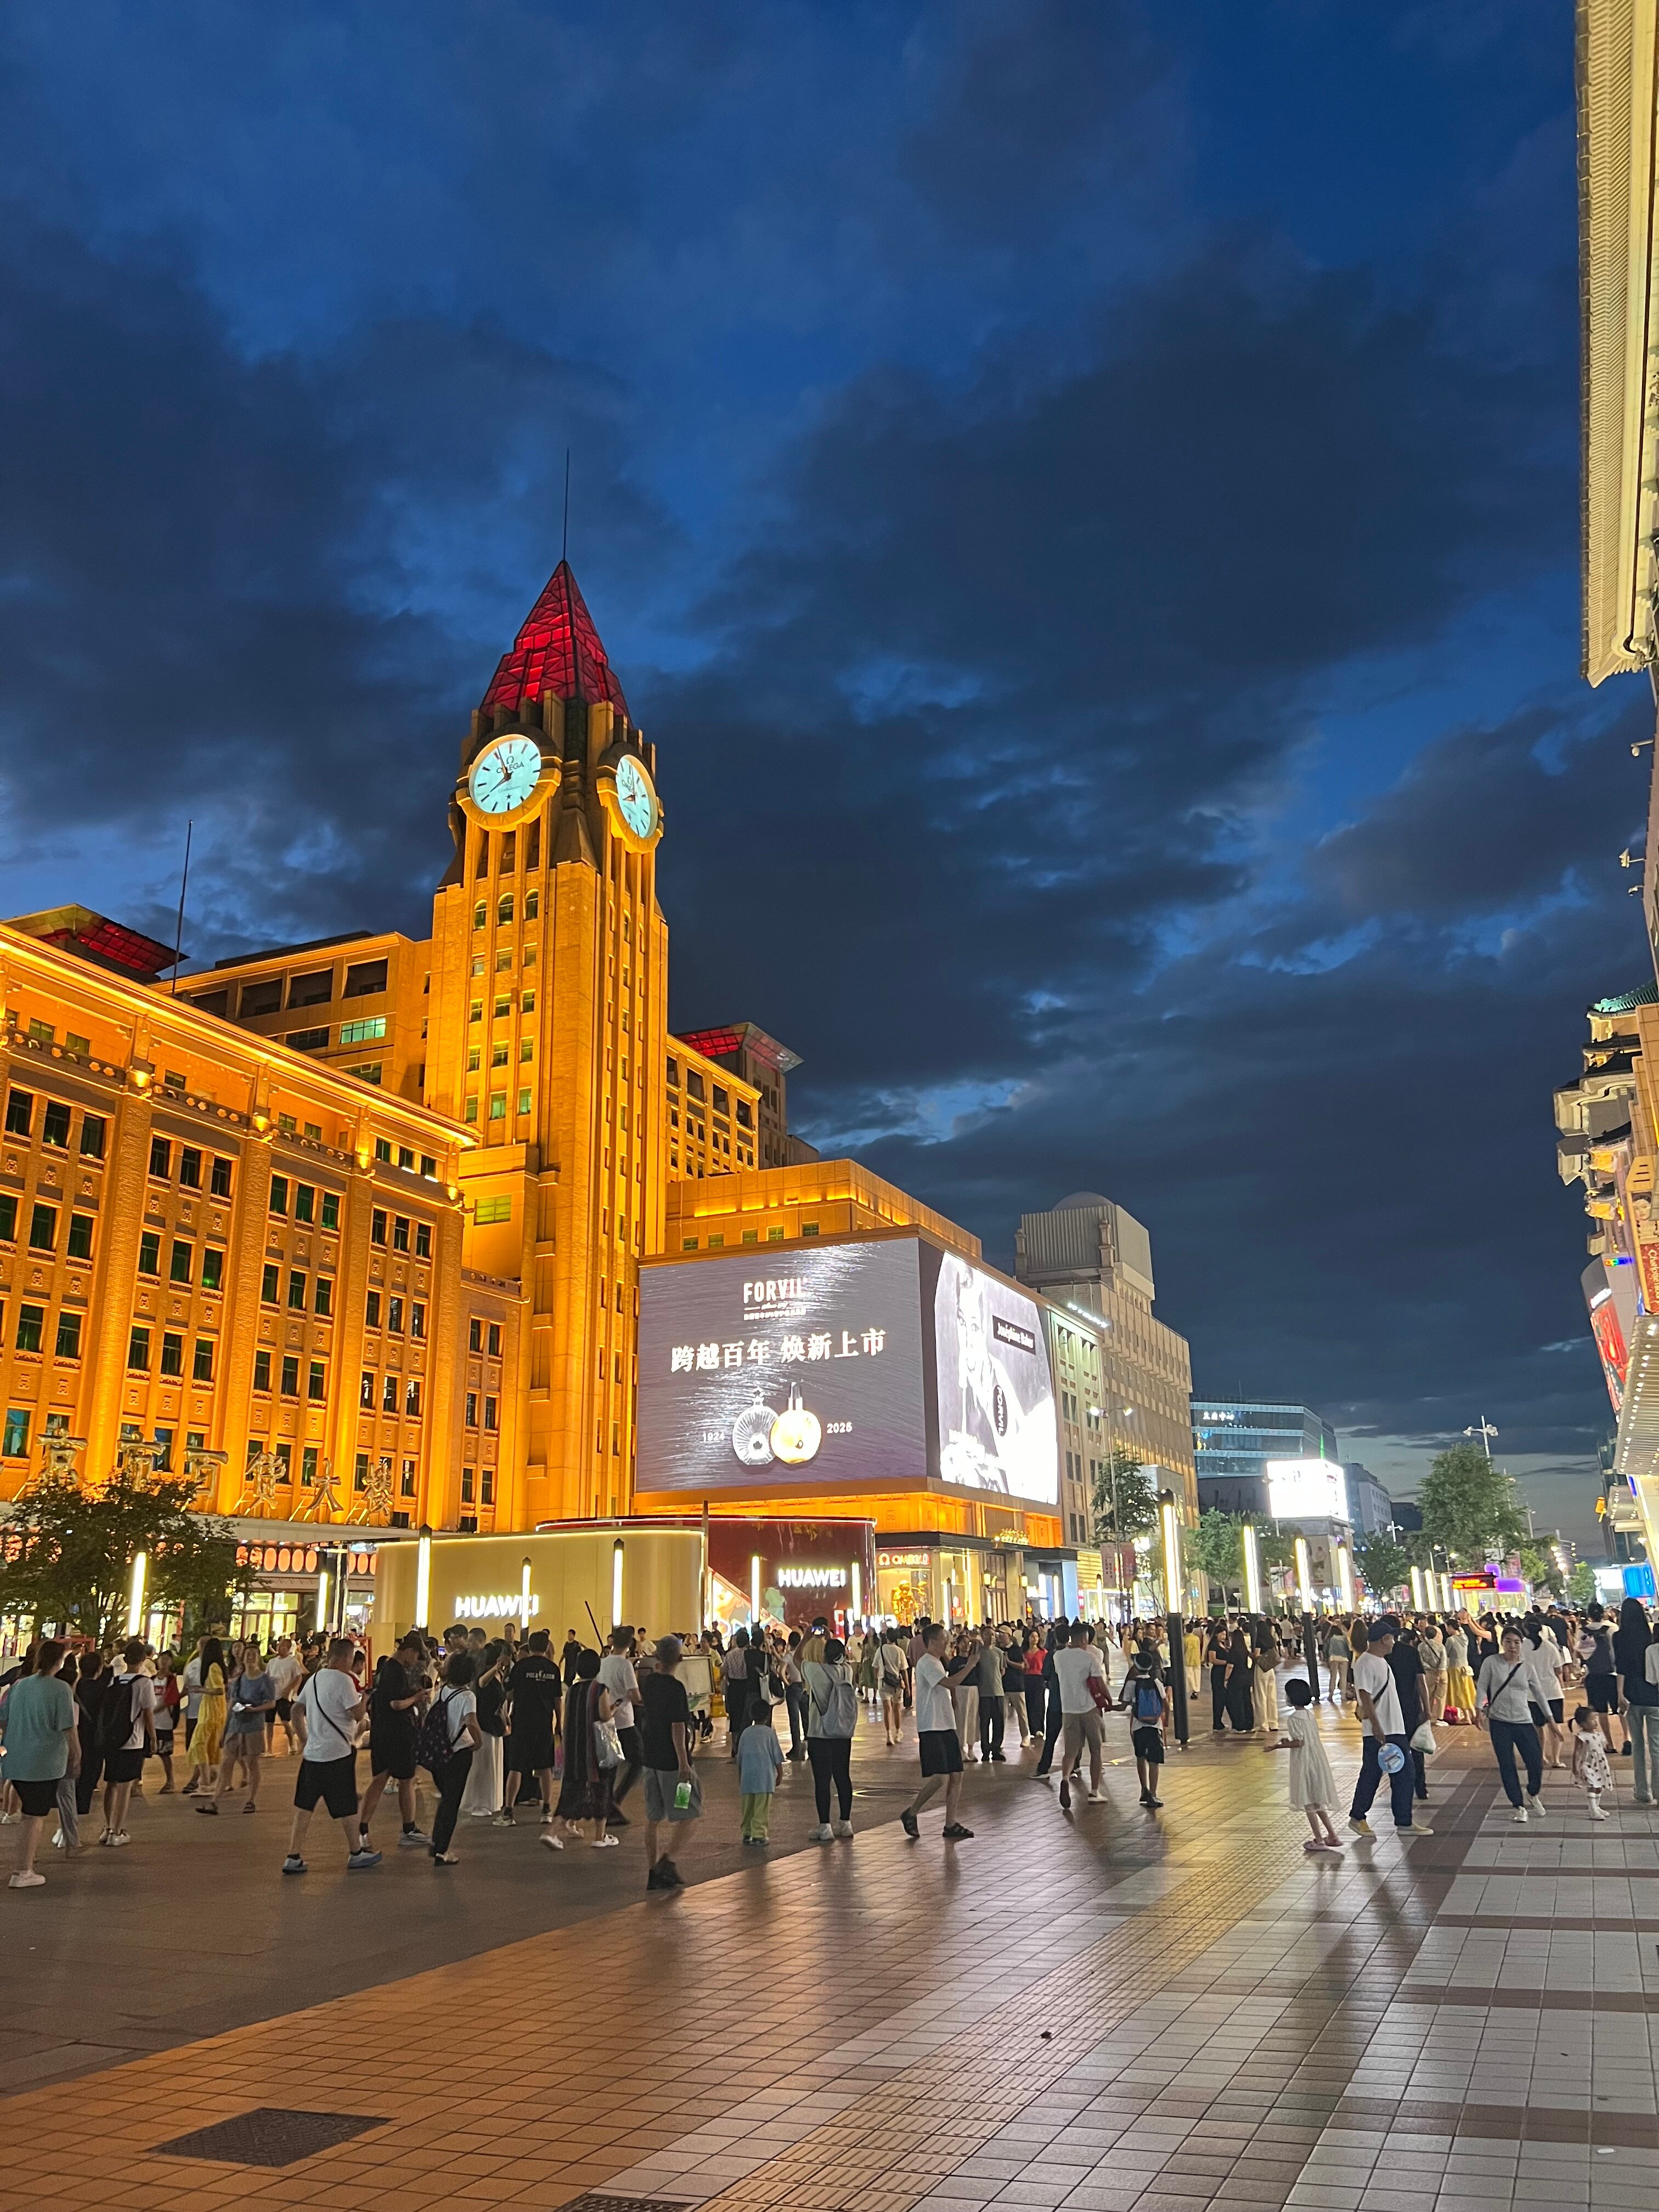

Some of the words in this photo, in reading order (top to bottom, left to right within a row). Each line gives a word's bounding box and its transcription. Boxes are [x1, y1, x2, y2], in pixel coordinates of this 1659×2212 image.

[496, 761, 524, 773] OEGA
[743, 1278, 808, 1304] FORVIL
[671, 1339, 770, 1373] 跨越百年
[780, 1328, 887, 1363] 焕新上市
[702, 1431, 725, 1442] 1924
[778, 1568, 845, 1587] HUAWEI
[455, 1594, 539, 1618] HUAWI
